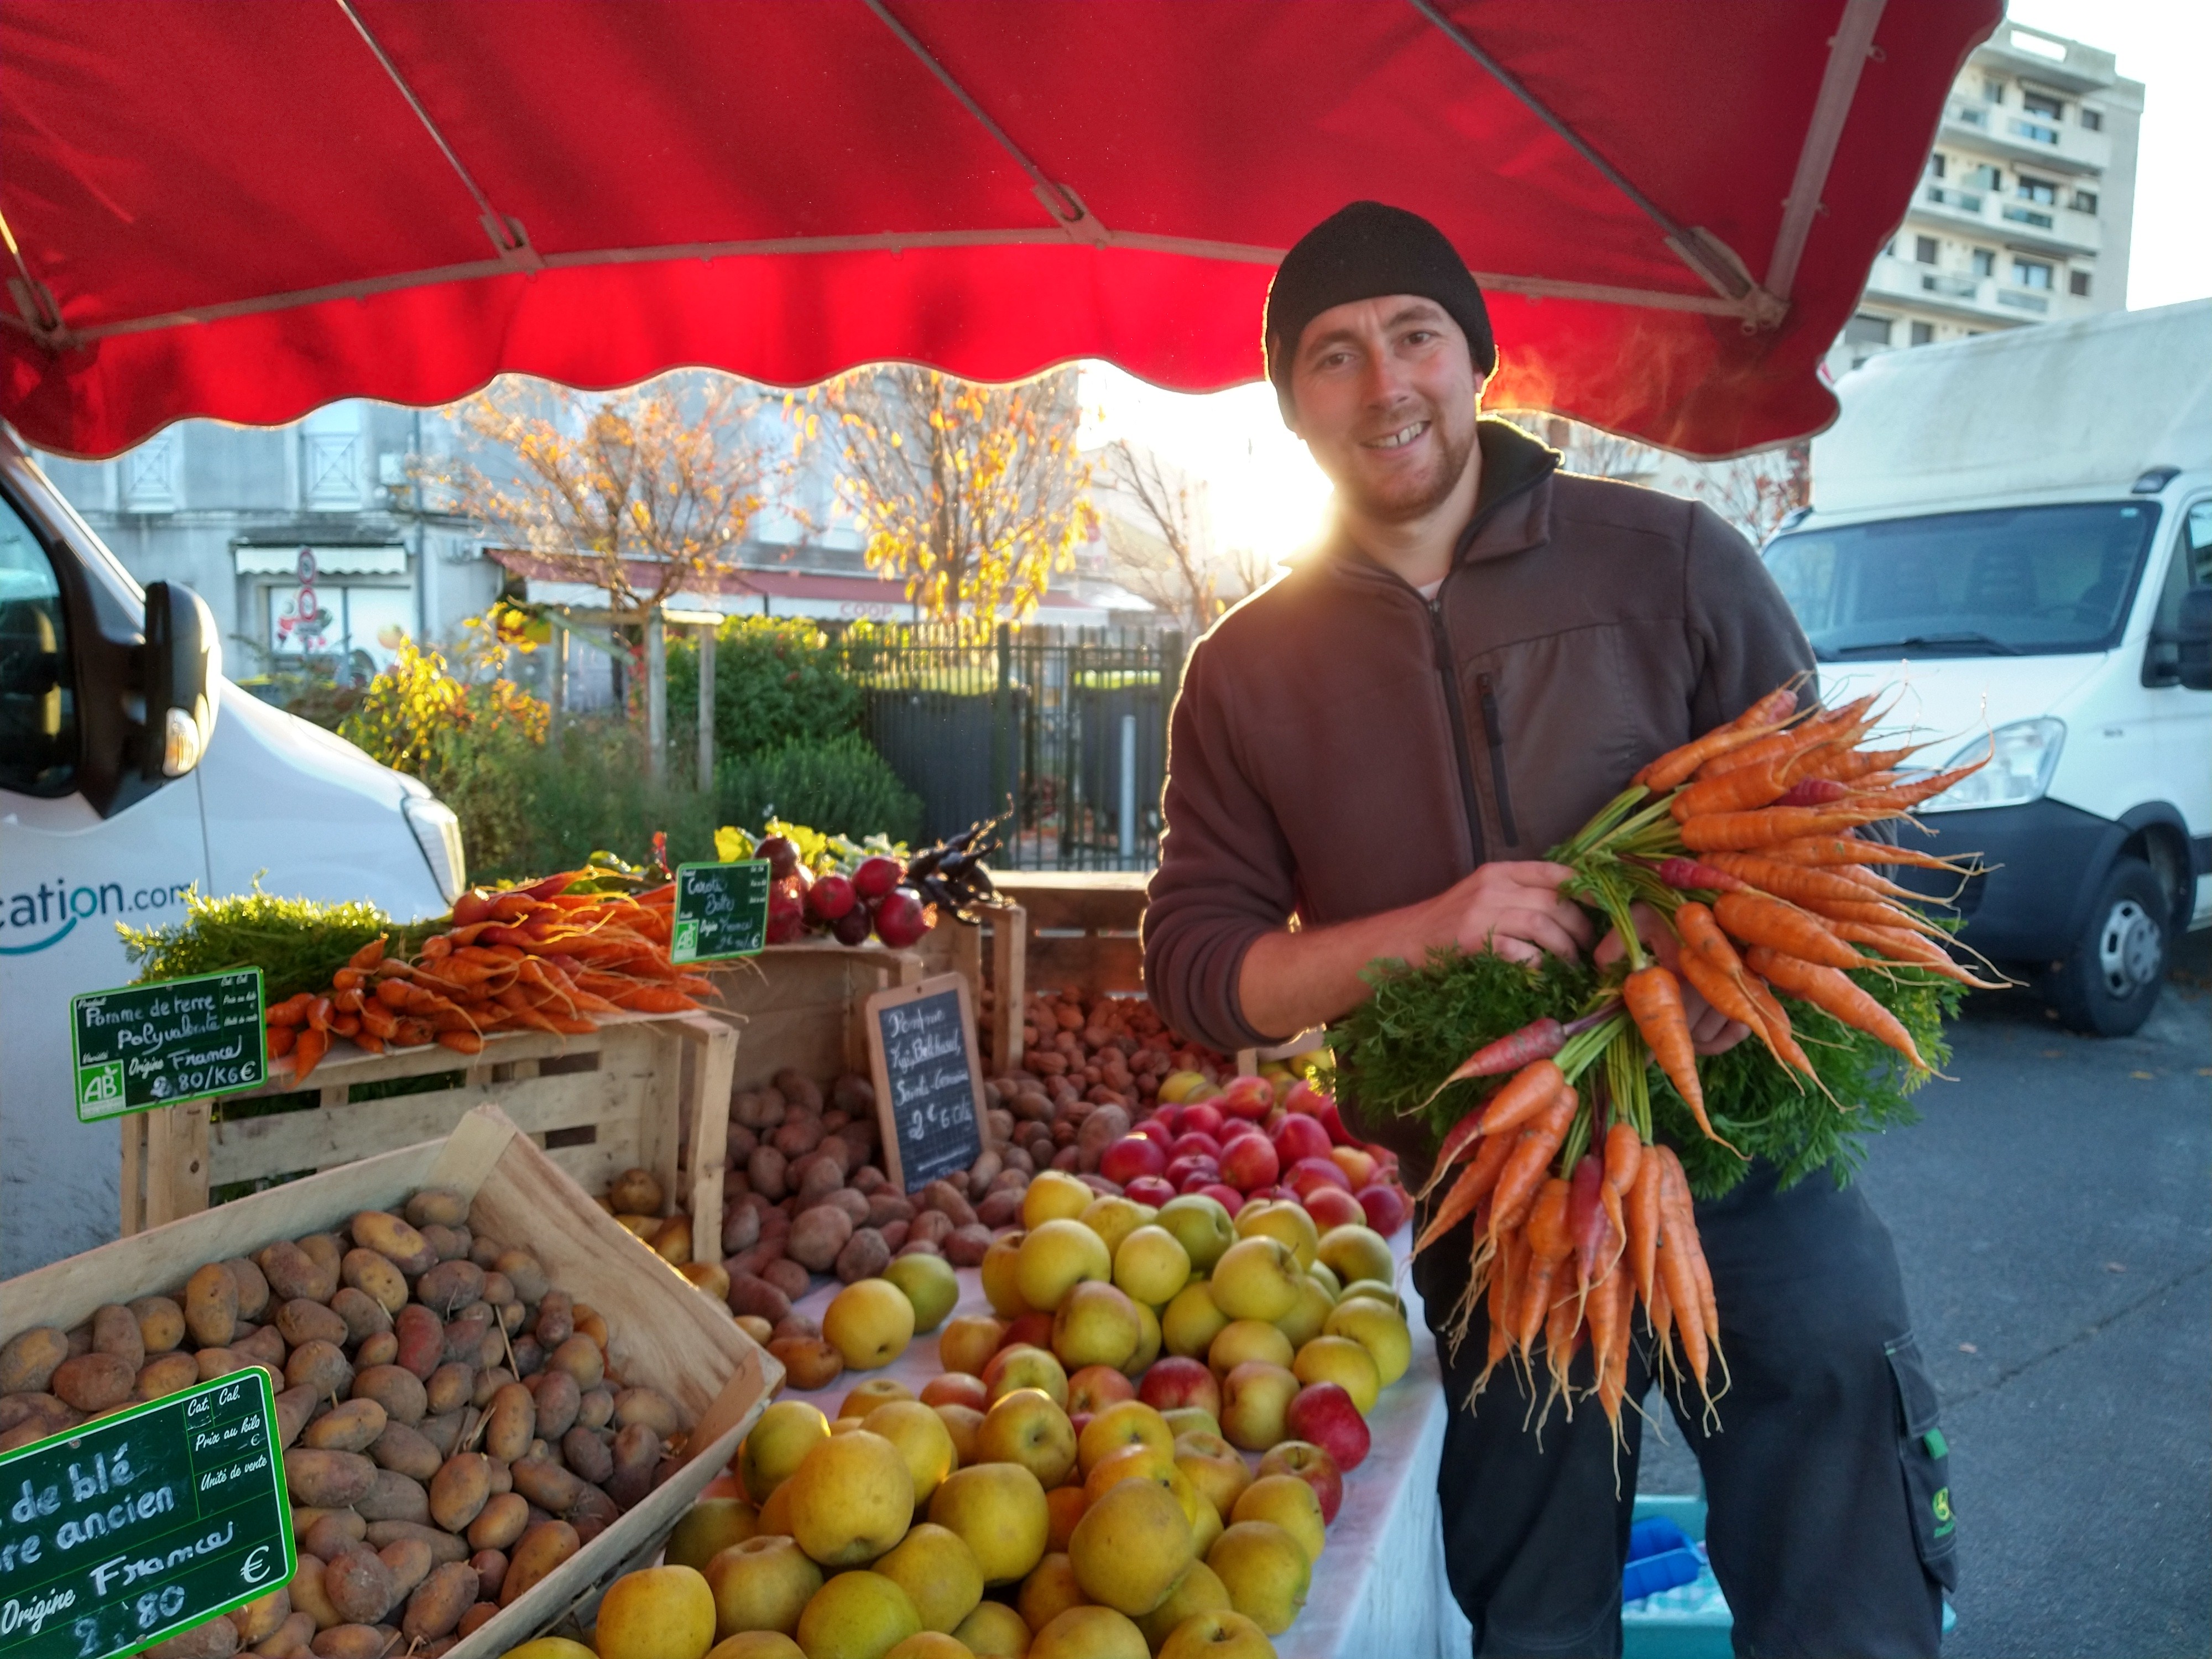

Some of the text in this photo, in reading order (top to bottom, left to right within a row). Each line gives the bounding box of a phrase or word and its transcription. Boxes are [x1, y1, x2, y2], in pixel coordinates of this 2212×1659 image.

[0, 878, 191, 927] ation.com
[85, 1006, 145, 1029] Pomme
[149, 997, 171, 1018] de
[174, 995, 217, 1014] terre
[167, 1035, 242, 1071] France
[84, 1073, 118, 1103] AB
[187, 1384, 241, 1417] Cat. Cal.
[195, 1413, 261, 1452] Prix au kilo
[251, 1433, 260, 1447] €
[11, 1441, 137, 1523] de blé
[200, 1454, 268, 1492] Unité de vente
[0, 1485, 175, 1573] re ancien
[1, 1520, 234, 1636] Origine France
[239, 1545, 271, 1584] €
